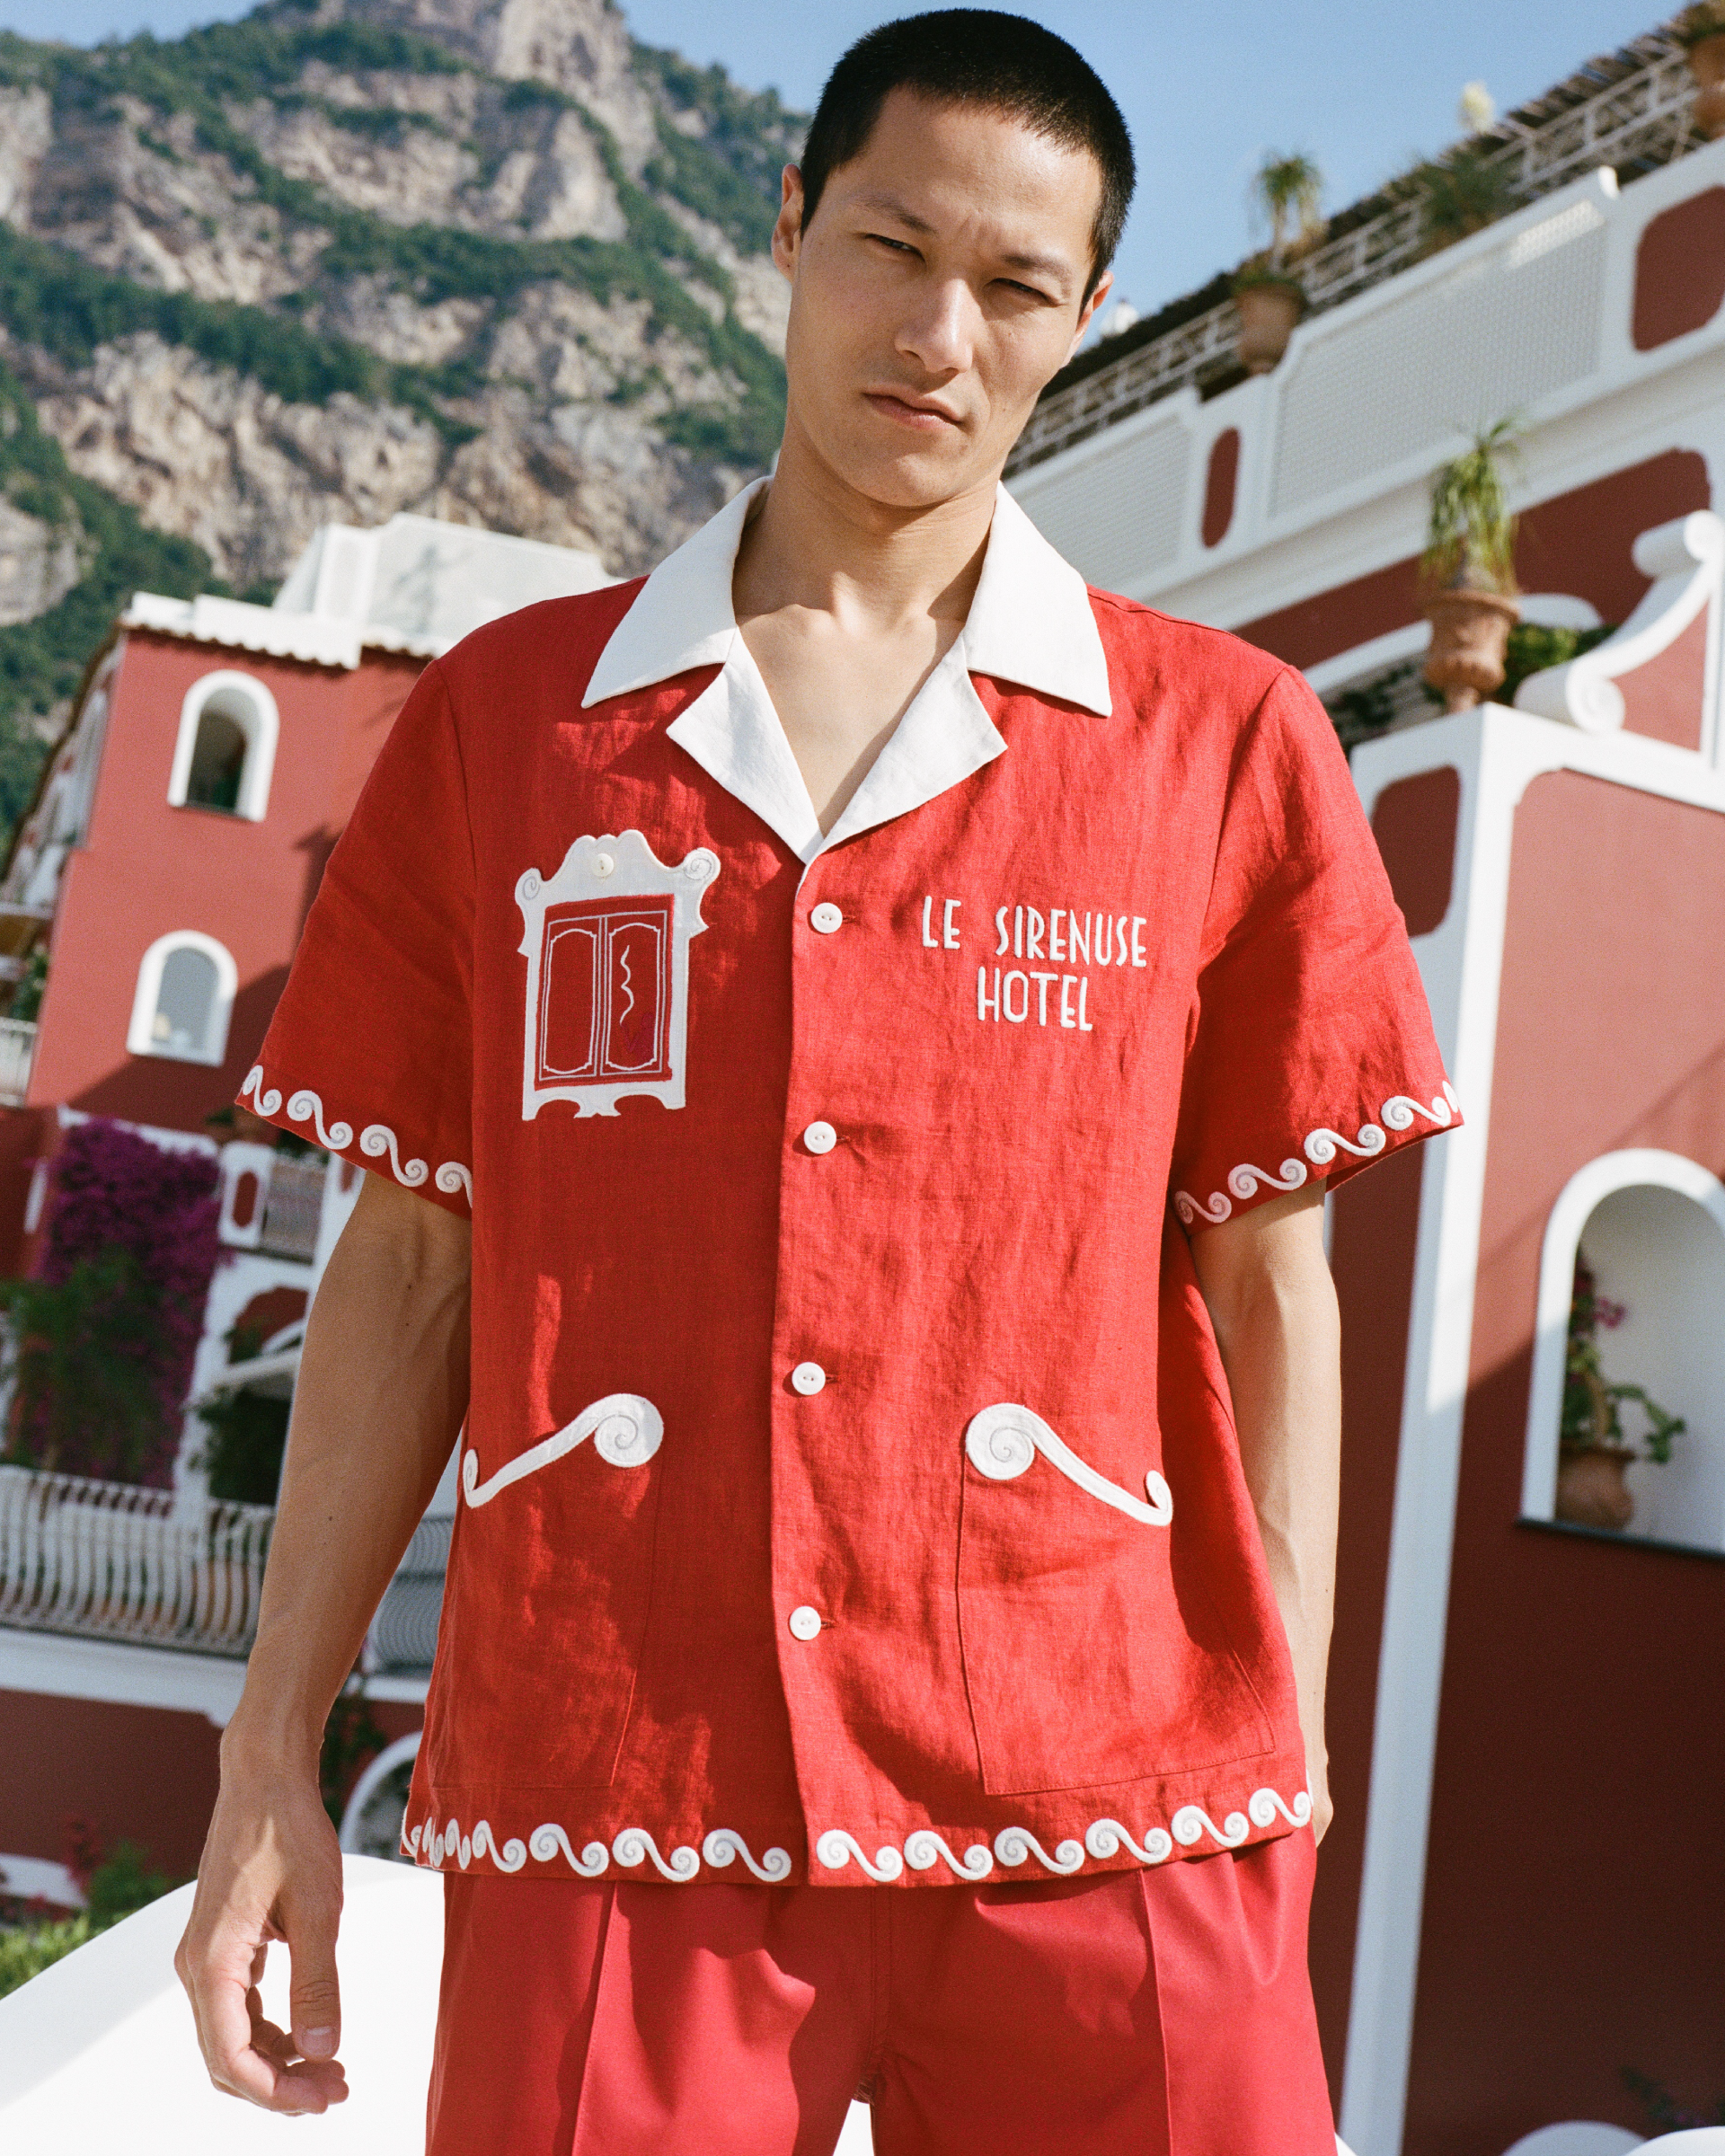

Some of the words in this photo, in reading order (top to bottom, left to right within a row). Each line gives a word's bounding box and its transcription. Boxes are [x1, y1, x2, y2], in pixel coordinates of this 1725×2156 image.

[922, 895, 961, 950] LE
[995, 905, 1147, 968] SIRENUSE
[977, 966, 1093, 1031] HOTEL
